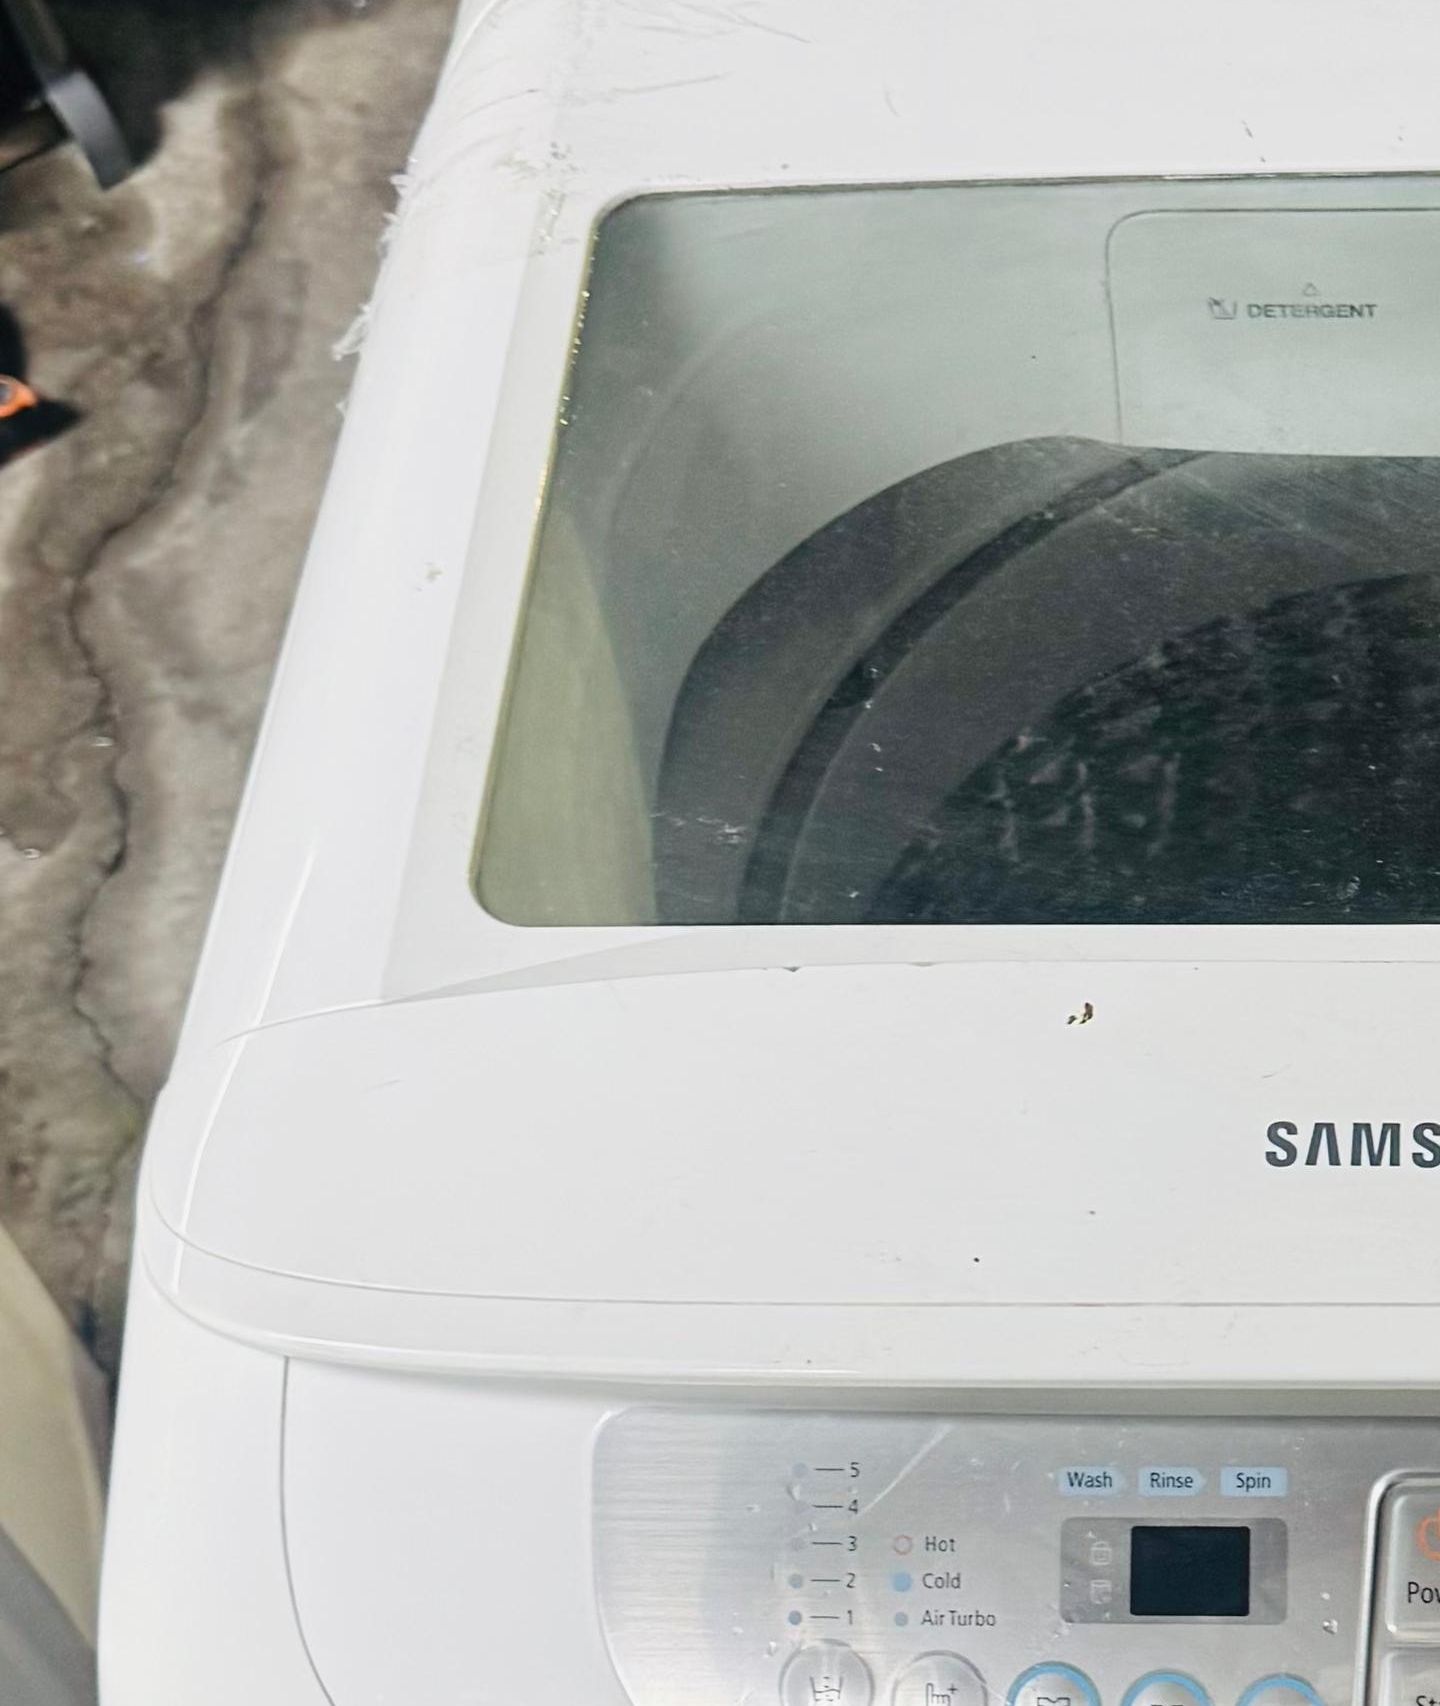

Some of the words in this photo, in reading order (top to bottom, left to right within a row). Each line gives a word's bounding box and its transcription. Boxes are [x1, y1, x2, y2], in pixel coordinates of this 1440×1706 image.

[1246, 302, 1378, 319] DETERGENT
[849, 1461, 860, 1478] 5
[1067, 1471, 1113, 1489] Wash
[1150, 1471, 1194, 1489] Rinse
[1235, 1472, 1272, 1493] Spin
[848, 1498, 859, 1514] 4
[847, 1535, 858, 1552] 3
[925, 1534, 956, 1553] Hot
[846, 1573, 857, 1589] 2
[922, 1571, 961, 1590] Cold
[920, 1609, 947, 1627] Air
[948, 1608, 996, 1627] Turbo
